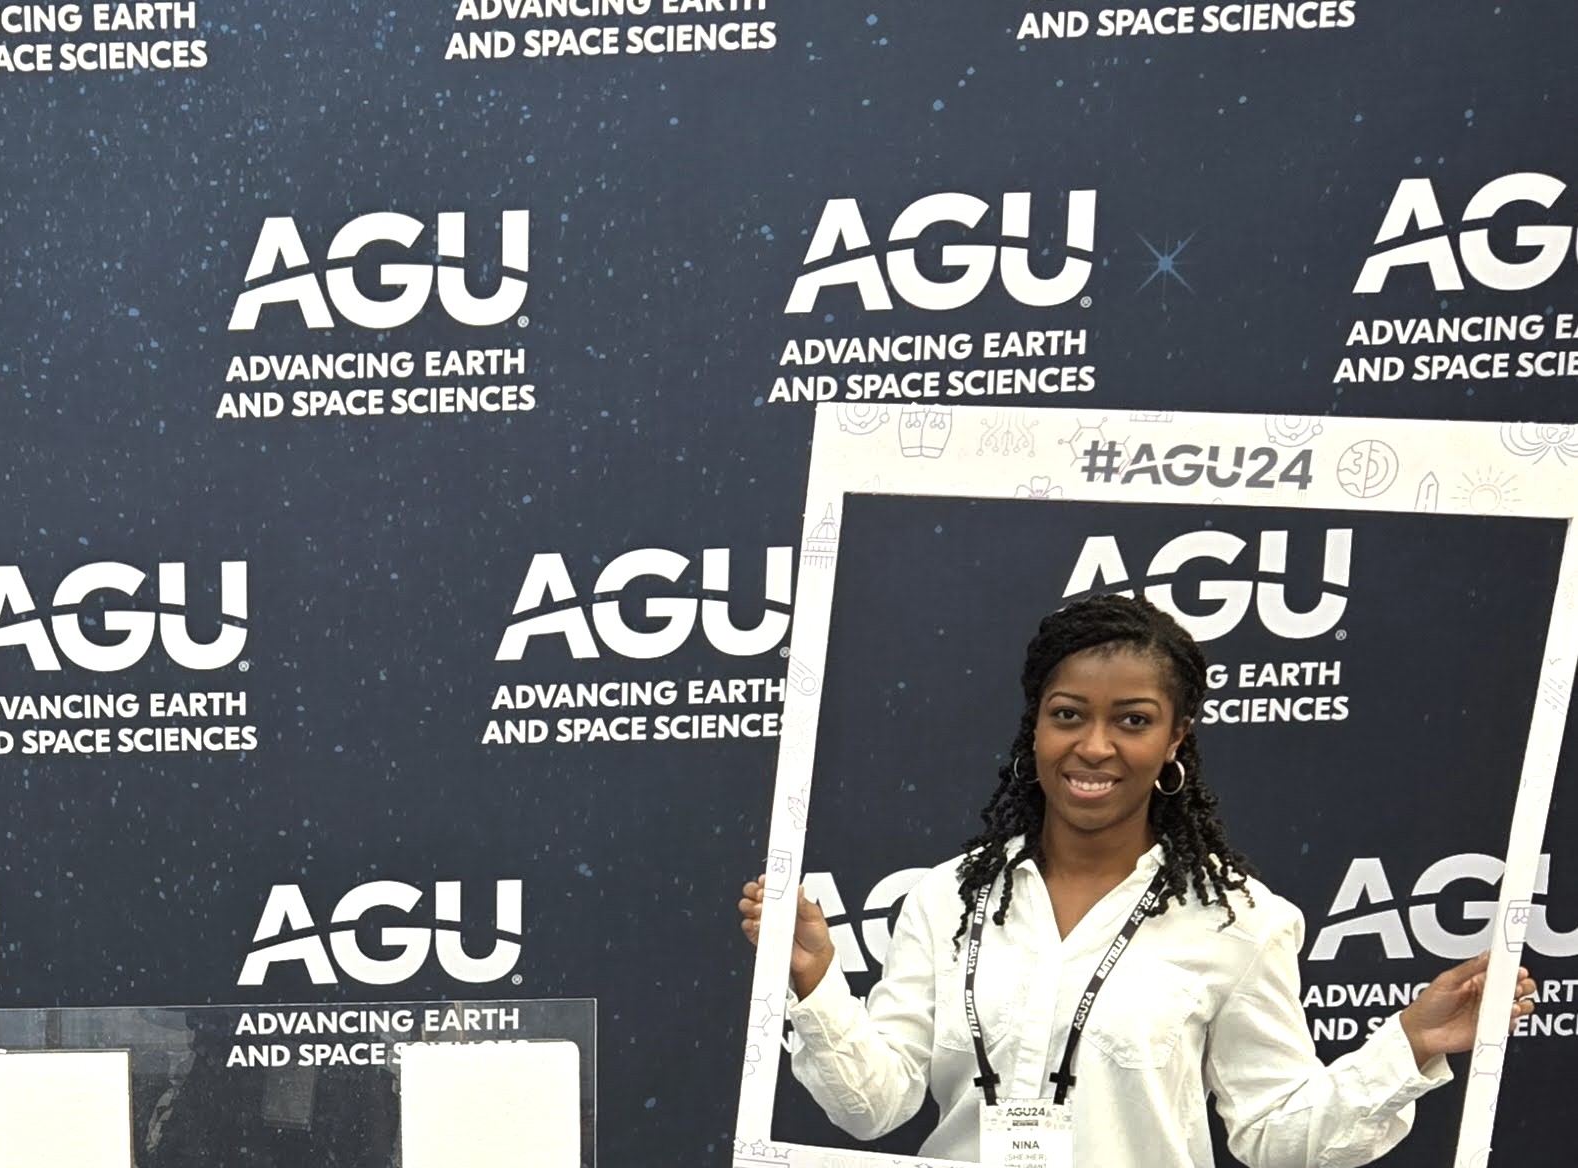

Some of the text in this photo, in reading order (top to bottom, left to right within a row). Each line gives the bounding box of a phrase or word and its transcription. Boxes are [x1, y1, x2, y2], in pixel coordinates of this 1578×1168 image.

[94, 2, 195, 30] EARTH
[1017, 0, 1355, 39] AND SPACE SCIENCES
[59, 40, 207, 70] SCIENCES
[445, 22, 776, 59] AND SPACE SCIENCES
[1352, 172, 1578, 294] AG
[784, 190, 1096, 313] AGU
[228, 210, 529, 330] AGU
[1346, 315, 1544, 346] ADVANCING
[780, 330, 1086, 365] ADVANCING EARTH
[226, 349, 524, 381] ADVANCING EARTH
[1333, 357, 1404, 383] AND
[1412, 353, 1509, 380] SPACE
[768, 366, 1095, 402] AND SPACE SCIENCES
[216, 385, 535, 418] AND SPACE SCIENCES
[1082, 441, 1312, 489] #AGU24
[495, 547, 793, 660] AGU
[1239, 661, 1340, 687] EARTH
[151, 692, 246, 717] EARTH
[492, 678, 785, 709] ADVANCING EARTH
[1200, 696, 1349, 724] SCIENCES
[22, 729, 110, 754] SPACE
[117, 726, 257, 752] SCIENCES
[482, 720, 548, 744] AND
[556, 717, 646, 742] SPACE
[237, 880, 522, 985] AGU
[236, 1008, 519, 1035] ADVANCING EARTH
[1313, 1018, 1359, 1041] ND
[227, 1045, 290, 1067] AND
[298, 1043, 385, 1066] SPACE
[1012, 1140, 1040, 1149] NINA
